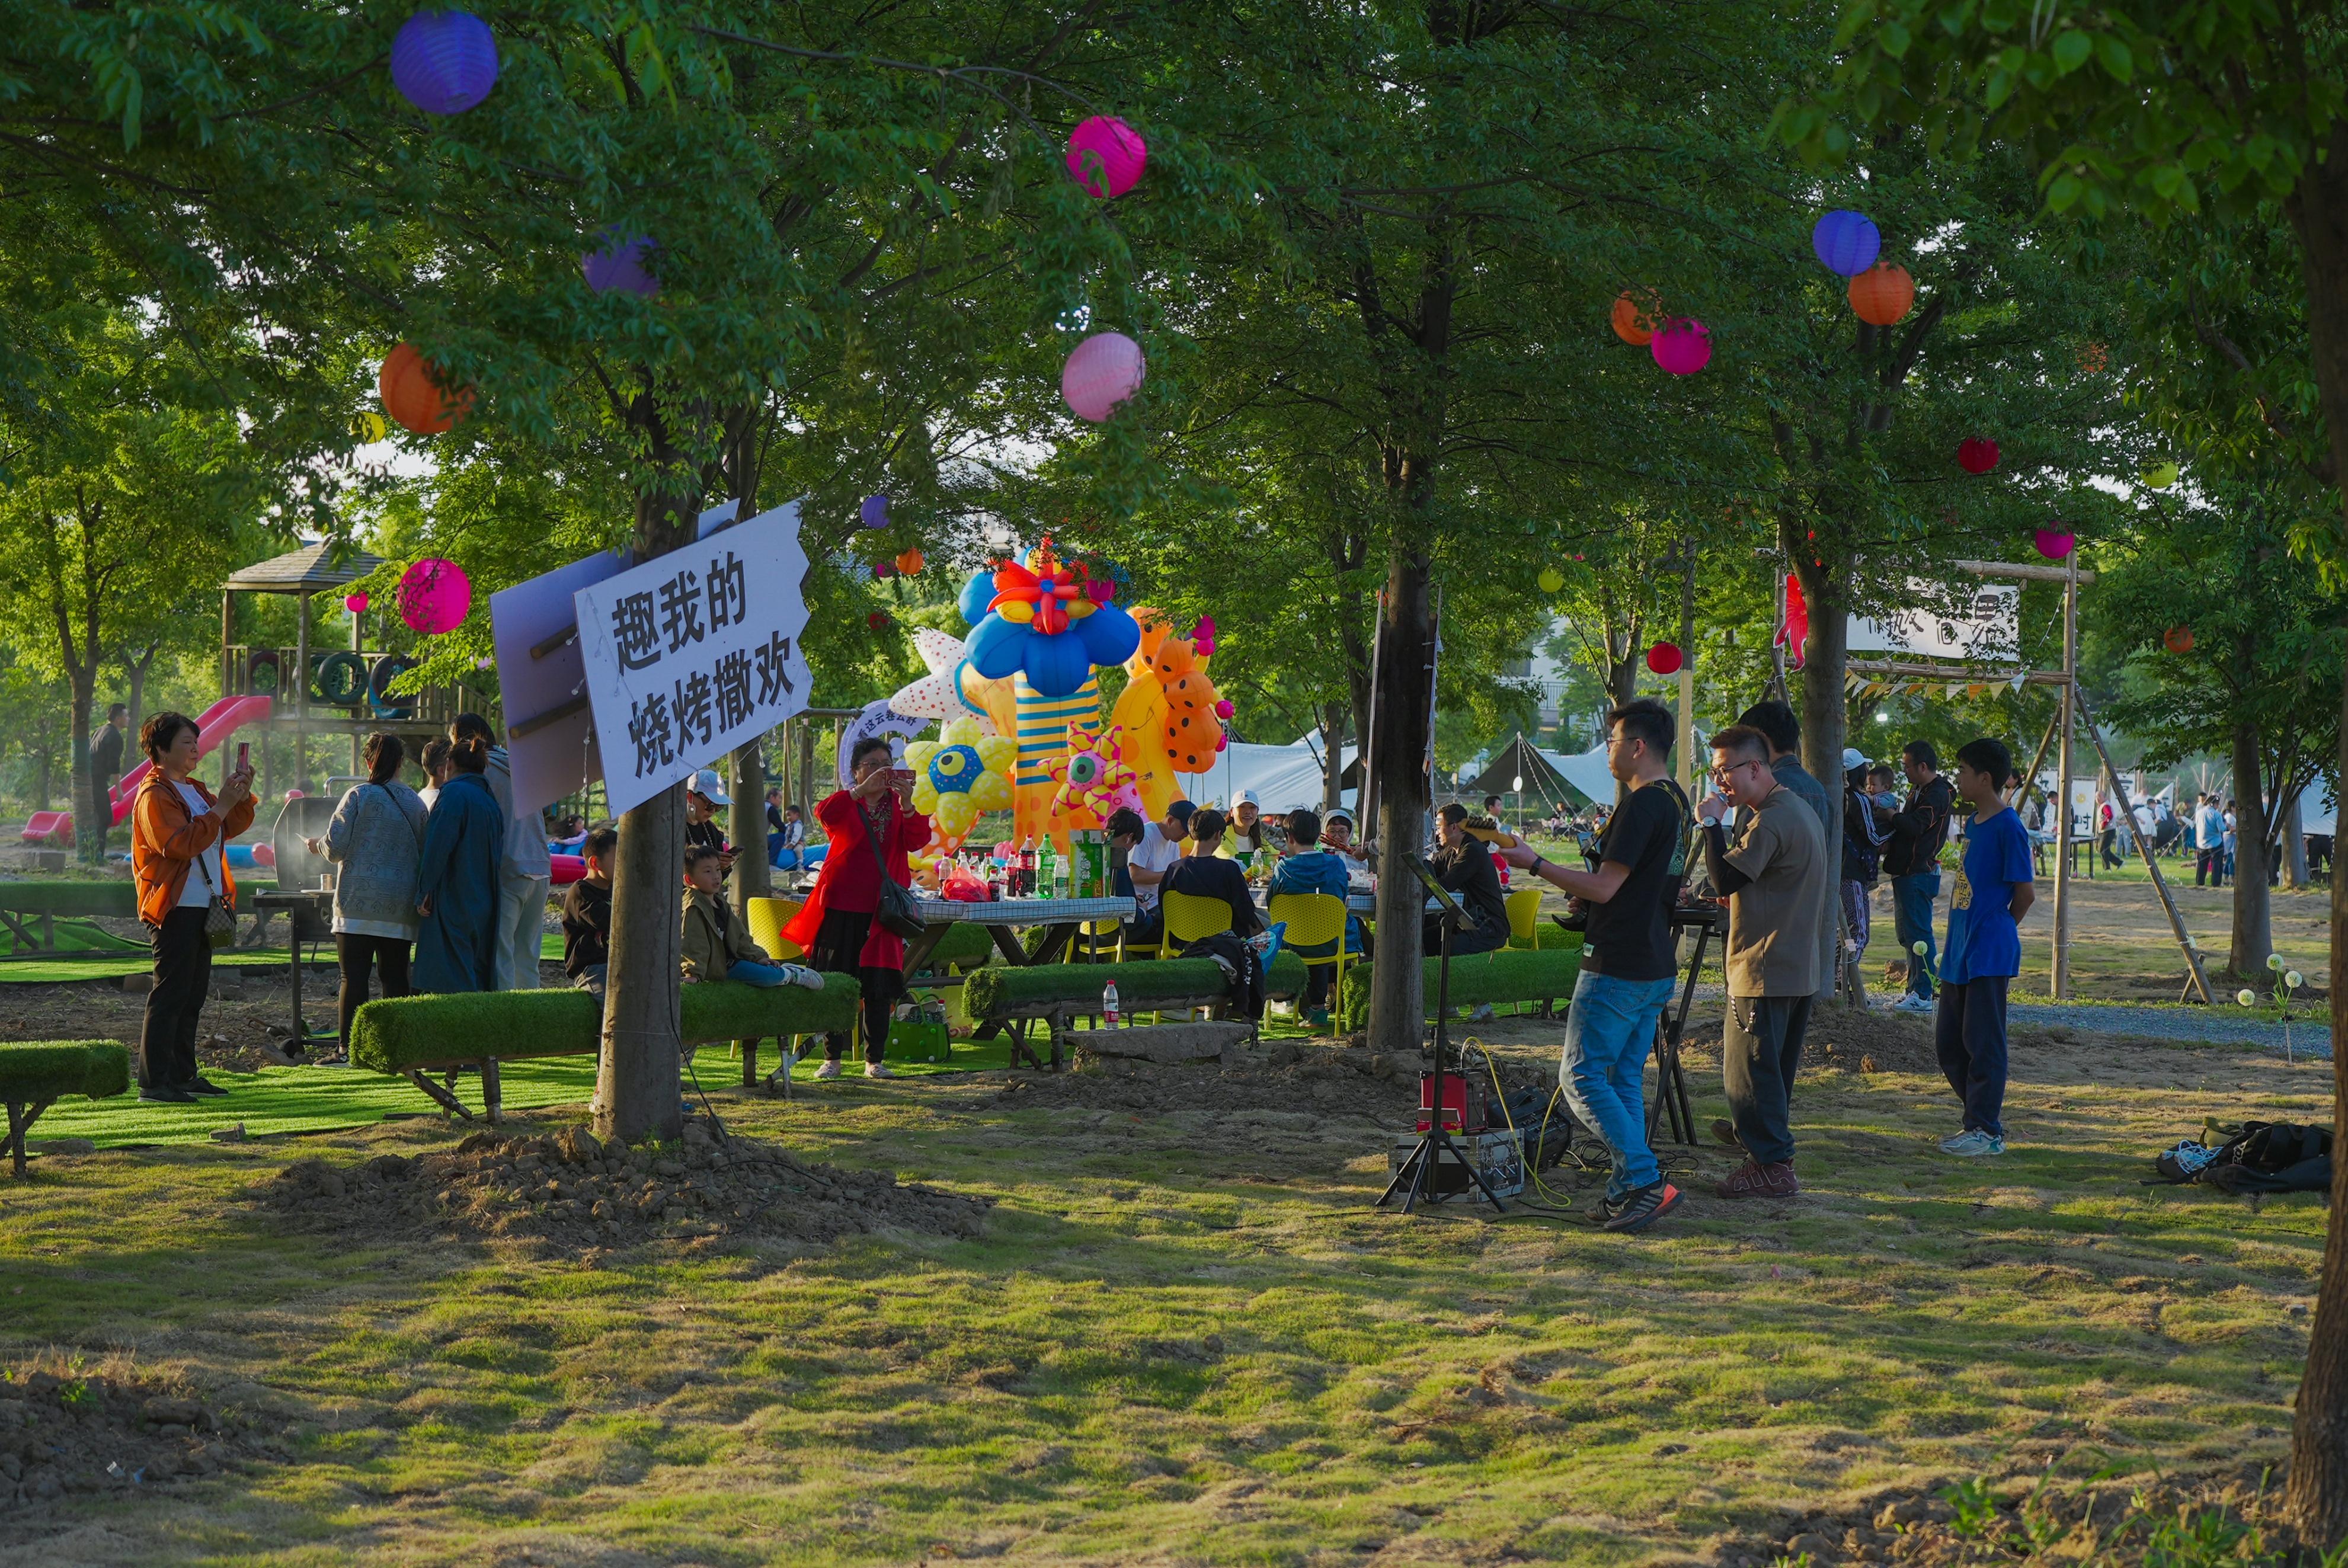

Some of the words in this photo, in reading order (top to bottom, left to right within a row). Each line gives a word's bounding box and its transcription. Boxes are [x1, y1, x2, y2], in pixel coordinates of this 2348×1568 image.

[612, 551, 746, 676] 趣我的
[628, 631, 794, 779] 烧烤撒欢
